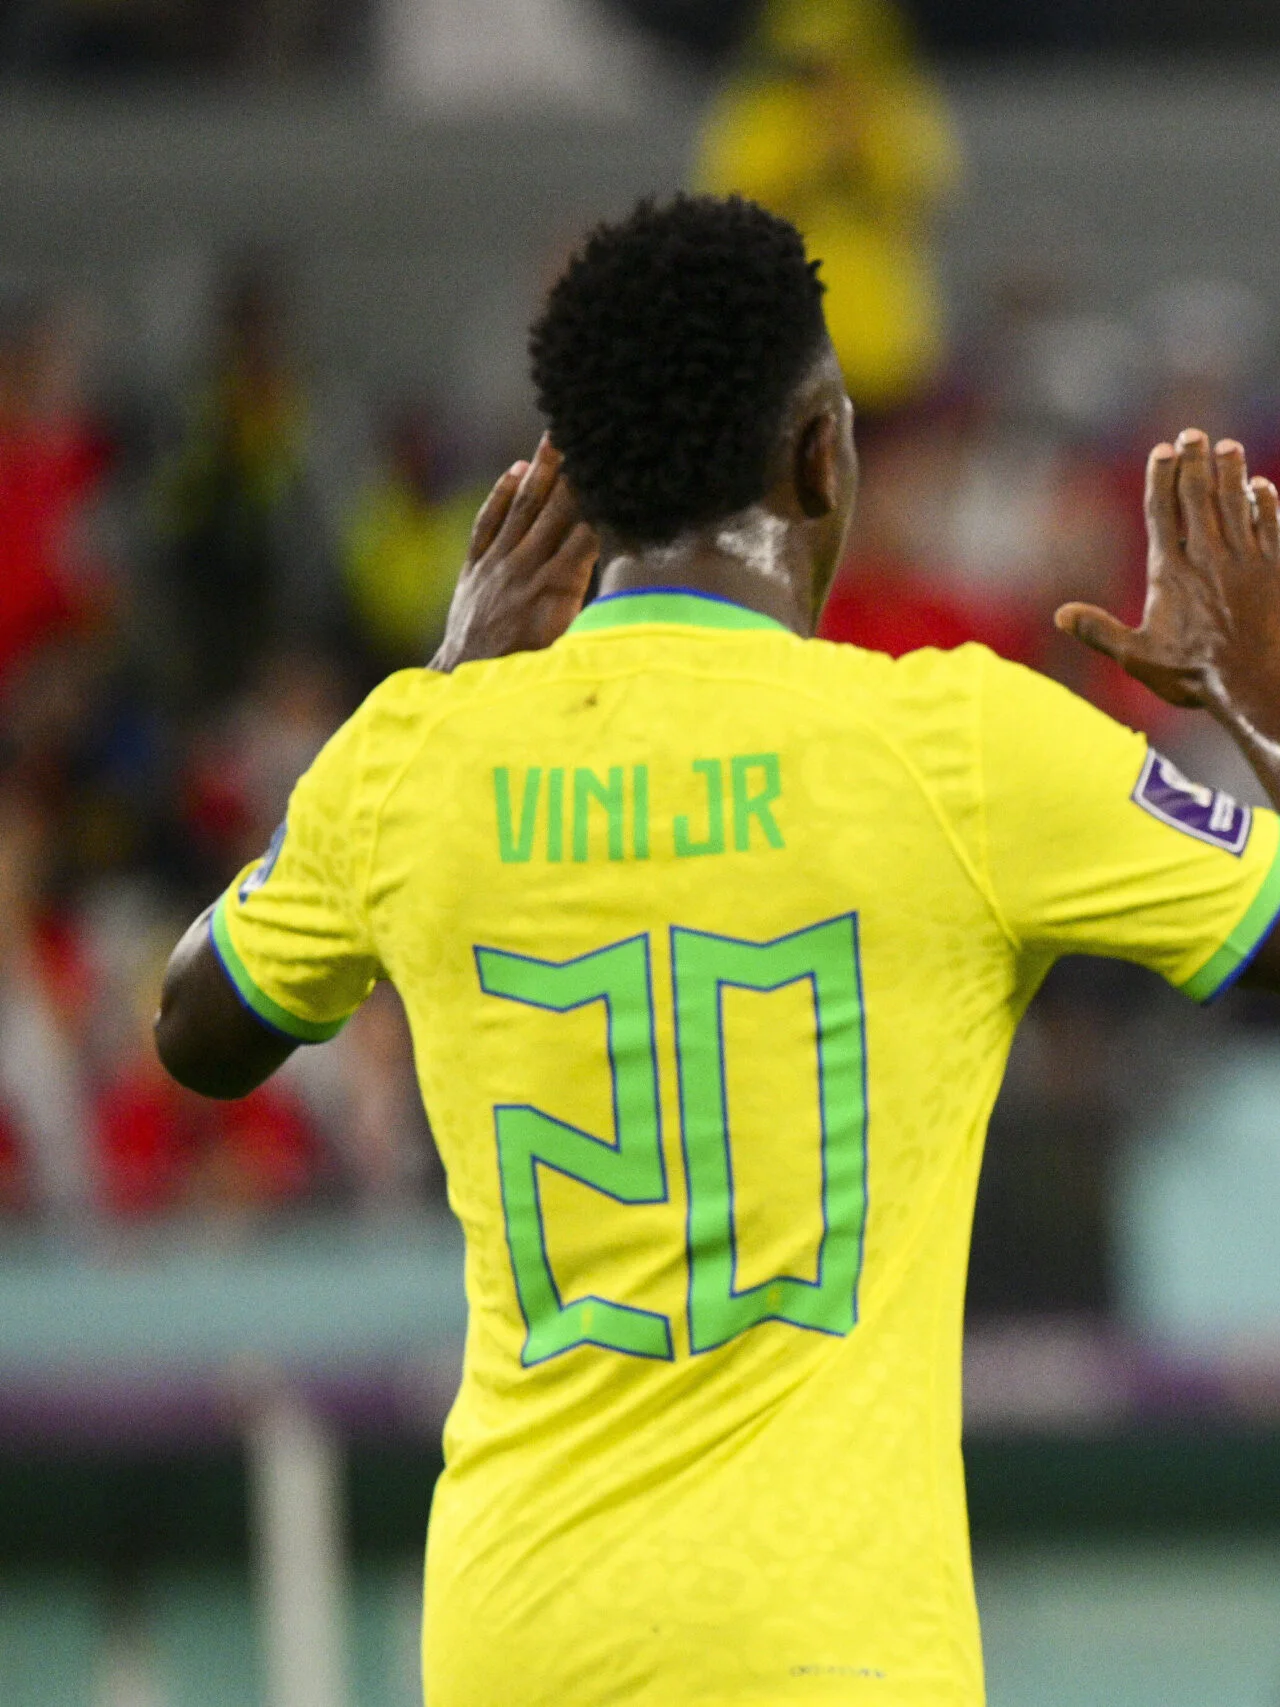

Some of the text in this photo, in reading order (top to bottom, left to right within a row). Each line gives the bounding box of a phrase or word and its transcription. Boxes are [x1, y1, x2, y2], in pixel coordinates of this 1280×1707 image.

[493, 751, 786, 864] VINI JR
[473, 911, 870, 1369] 20
